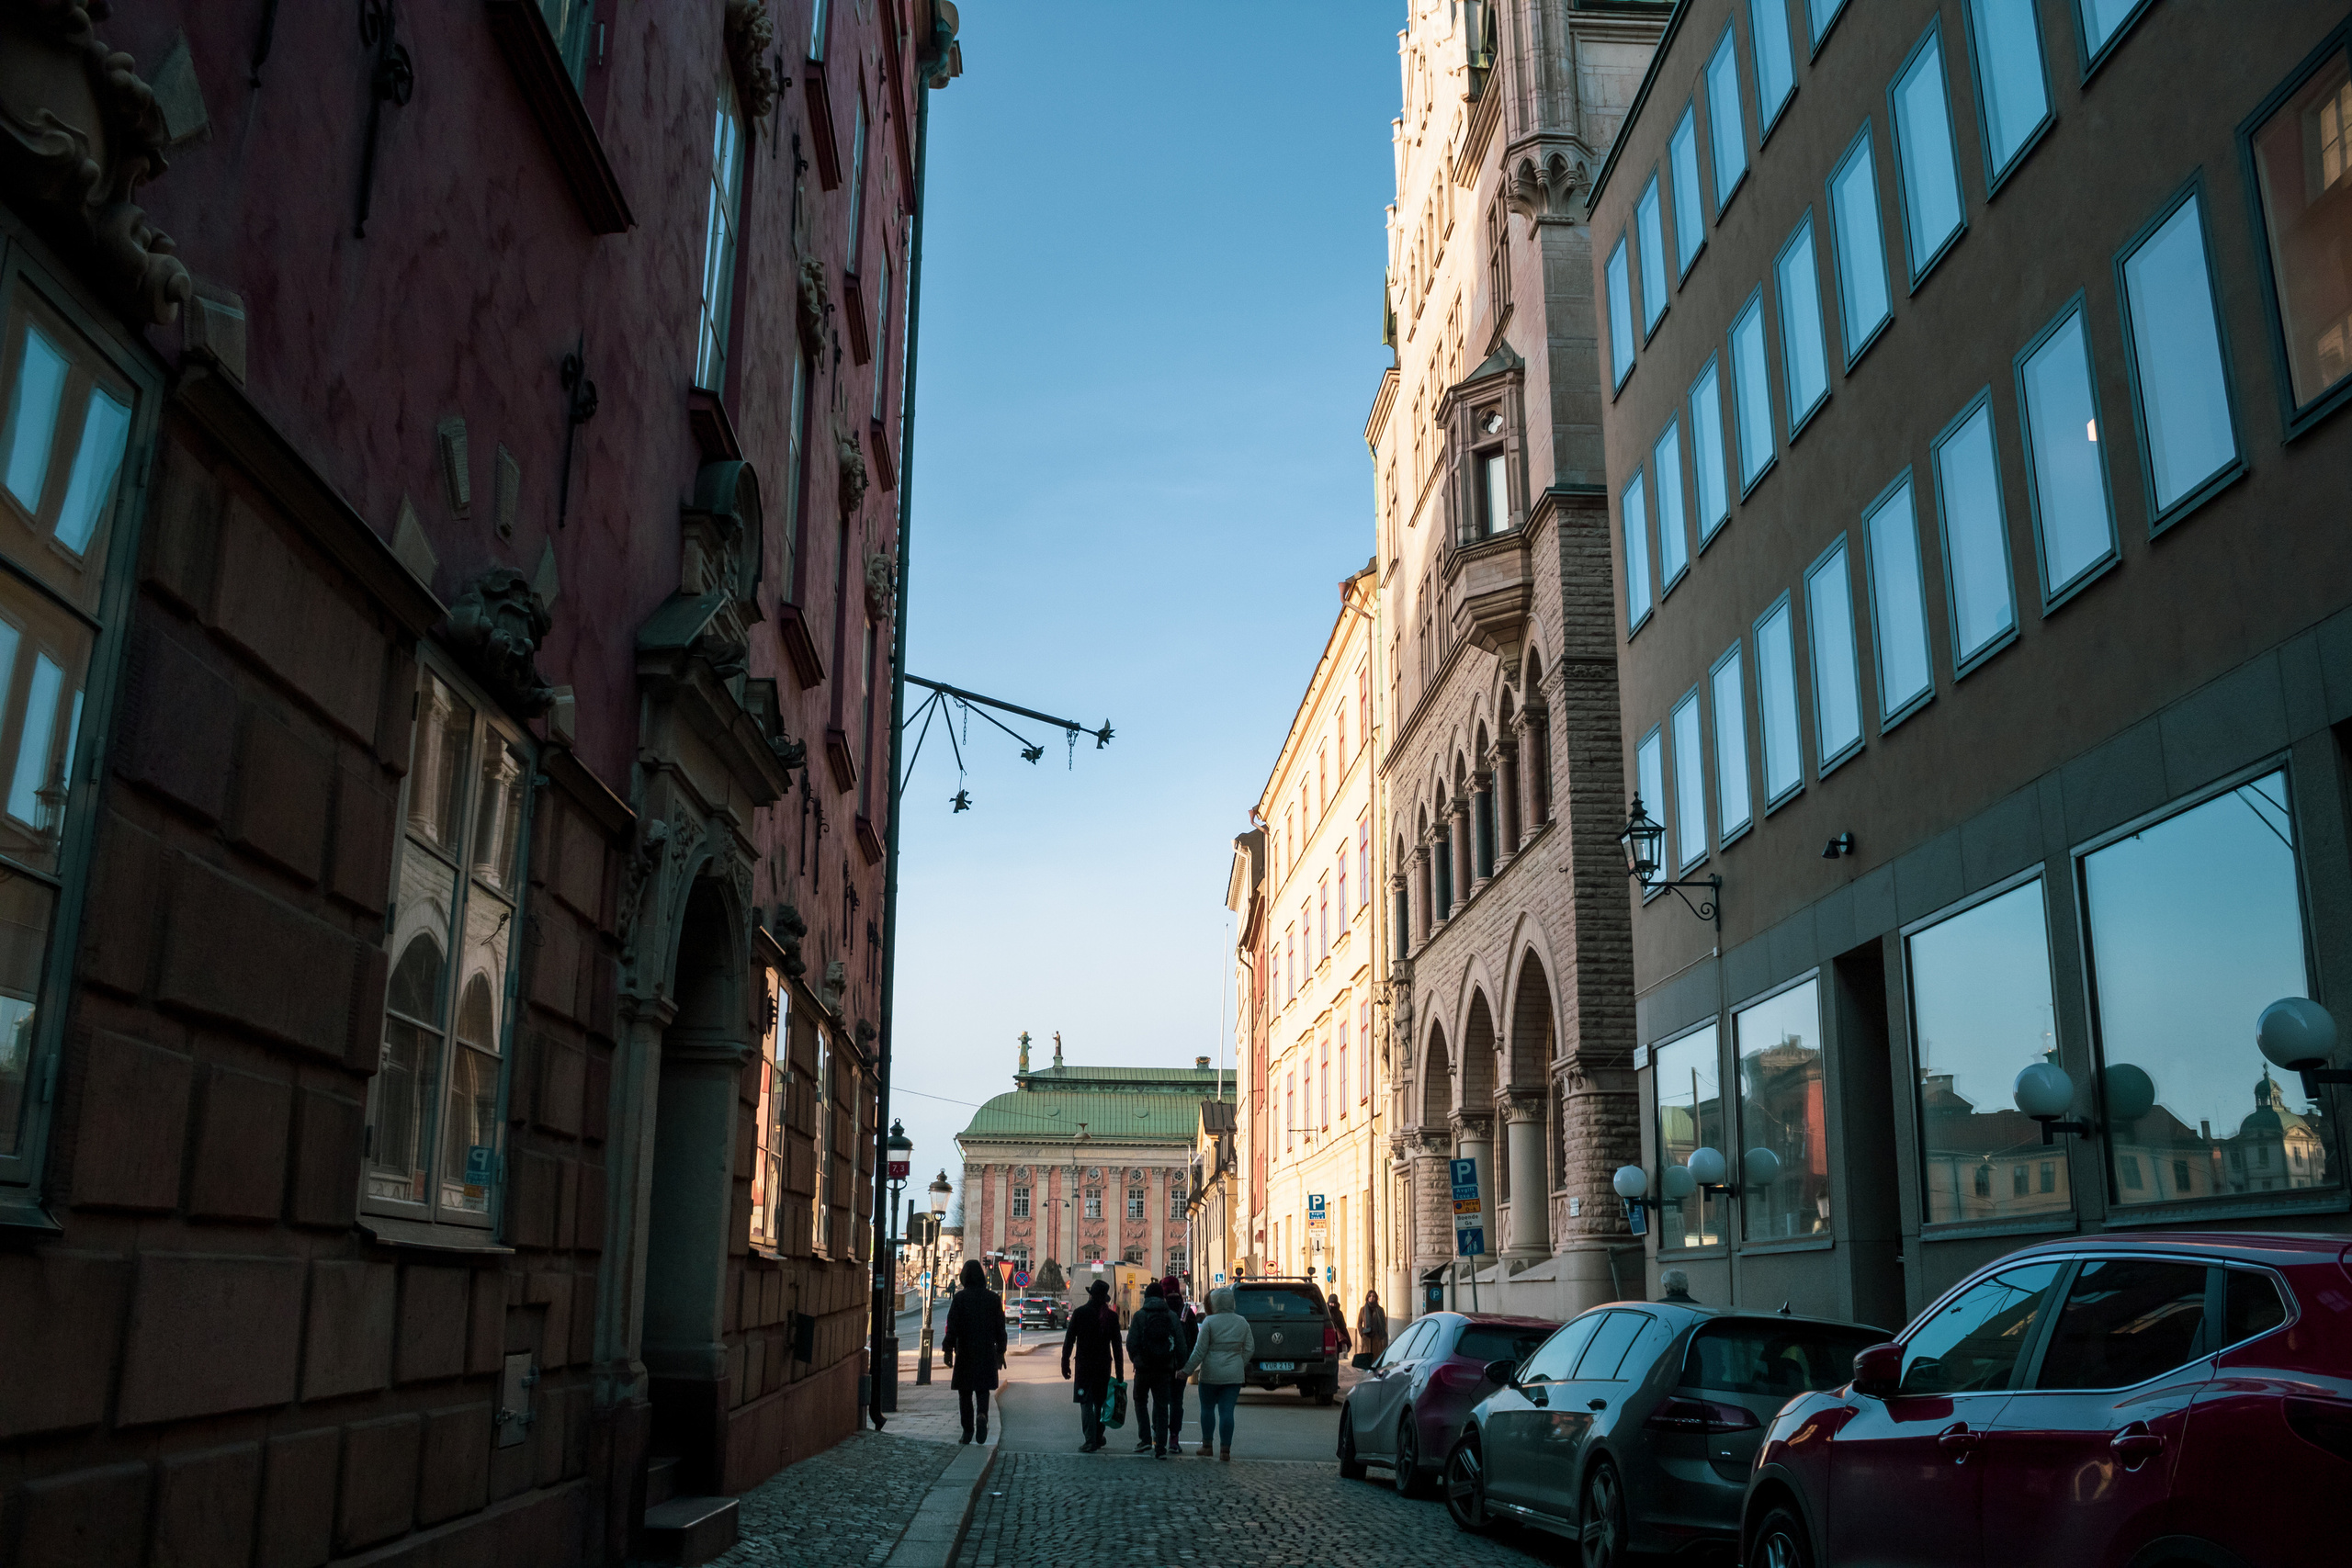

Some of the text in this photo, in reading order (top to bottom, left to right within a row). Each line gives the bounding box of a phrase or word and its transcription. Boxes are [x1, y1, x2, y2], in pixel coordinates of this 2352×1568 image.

[1456, 1161, 1472, 1183] P
[1312, 1195, 1323, 1210] P
[1432, 1290, 1440, 1299] P
[1265, 1361, 1292, 1370] YUR 215
